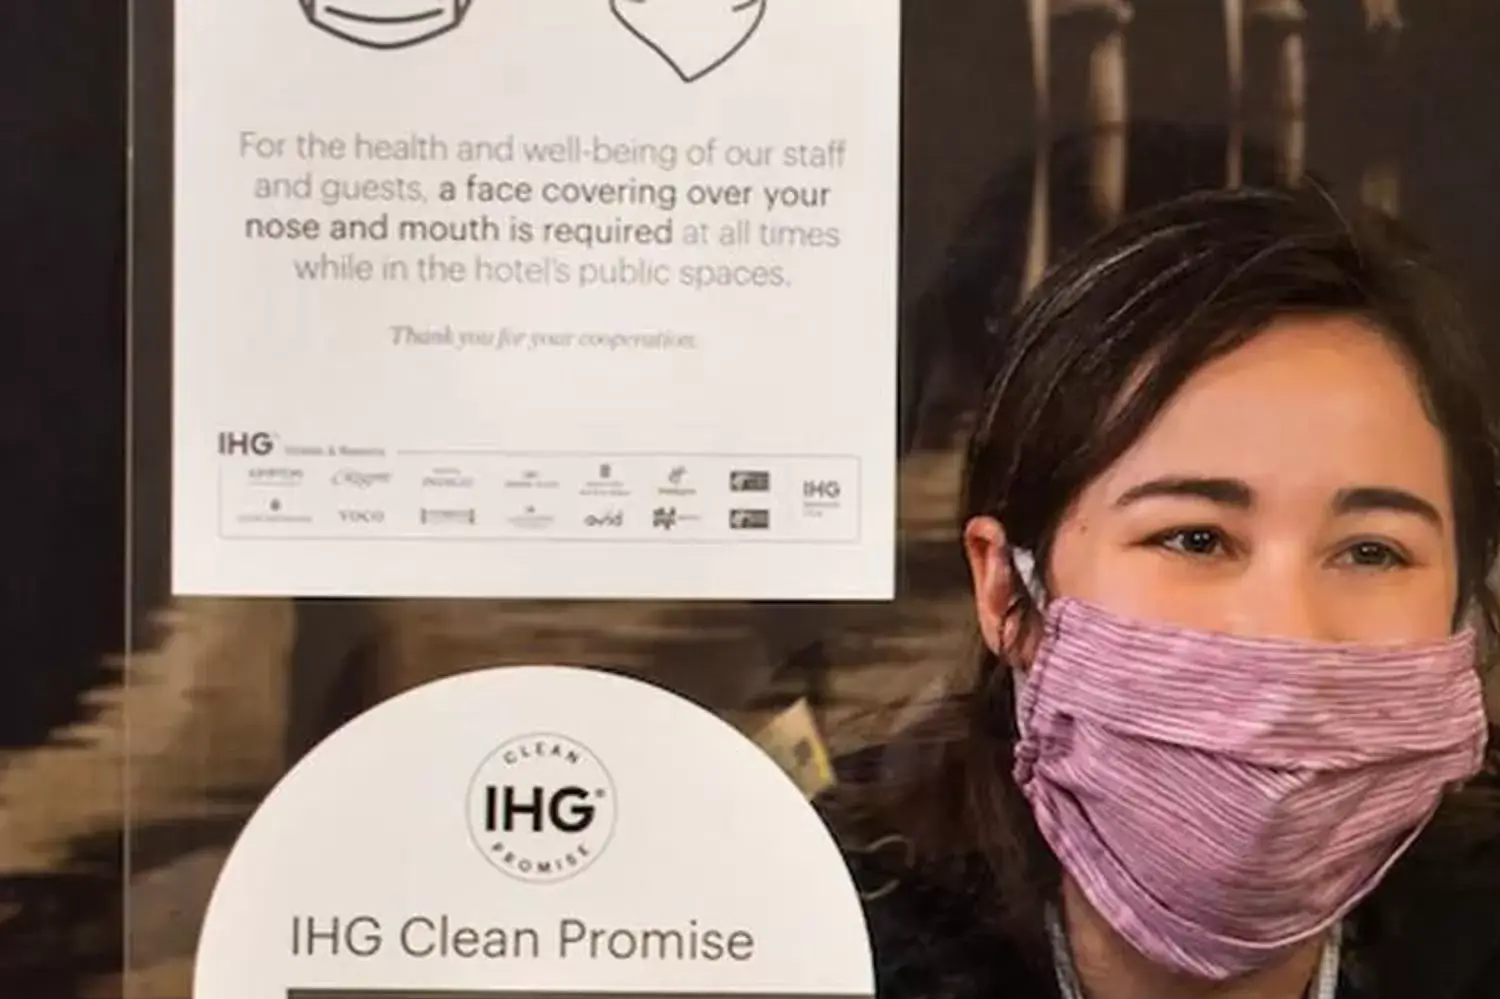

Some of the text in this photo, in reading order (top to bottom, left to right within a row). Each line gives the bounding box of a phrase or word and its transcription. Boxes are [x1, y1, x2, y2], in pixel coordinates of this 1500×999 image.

[240, 131, 846, 170] For the health and well-being of our staff
[254, 172, 832, 212] and guests, a face covering over your
[245, 212, 841, 250] nose and mouth is required at all times
[293, 252, 373, 282] while
[382, 255, 409, 281] in
[417, 254, 466, 283] the
[579, 258, 670, 289] public
[680, 264, 791, 291] spaces.
[218, 432, 274, 456] IHG
[503, 741, 578, 765] CLEAN
[486, 785, 595, 833] IHG
[492, 842, 589, 873] PROMISE
[291, 914, 755, 961] IHG Clean Promise
